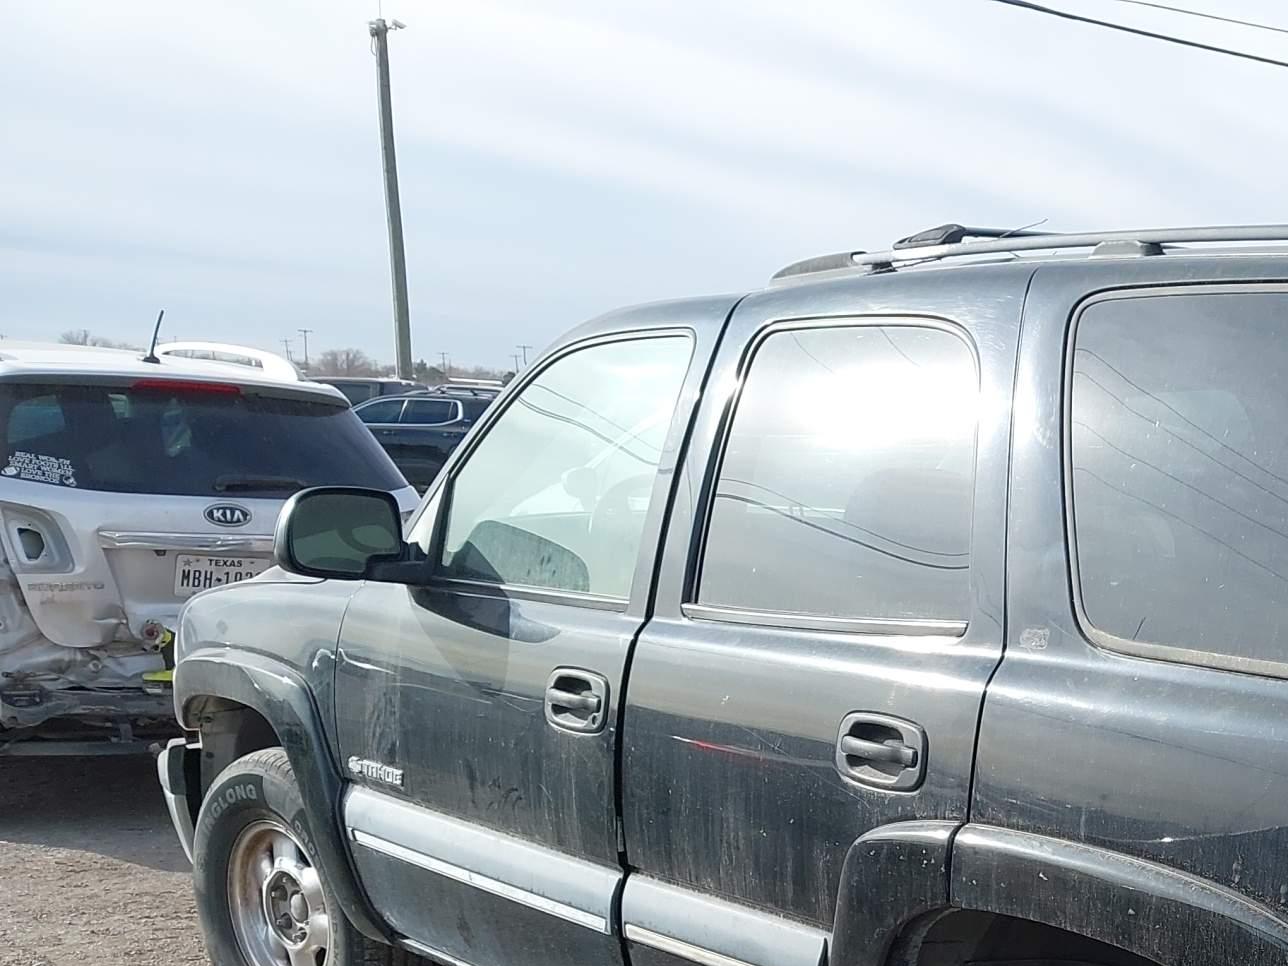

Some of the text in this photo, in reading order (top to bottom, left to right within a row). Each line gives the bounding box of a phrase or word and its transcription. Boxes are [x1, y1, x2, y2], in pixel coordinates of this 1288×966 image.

[212, 508, 245, 522] KIA
[208, 558, 243, 568] TEXAS
[362, 759, 404, 786] TAHOE
